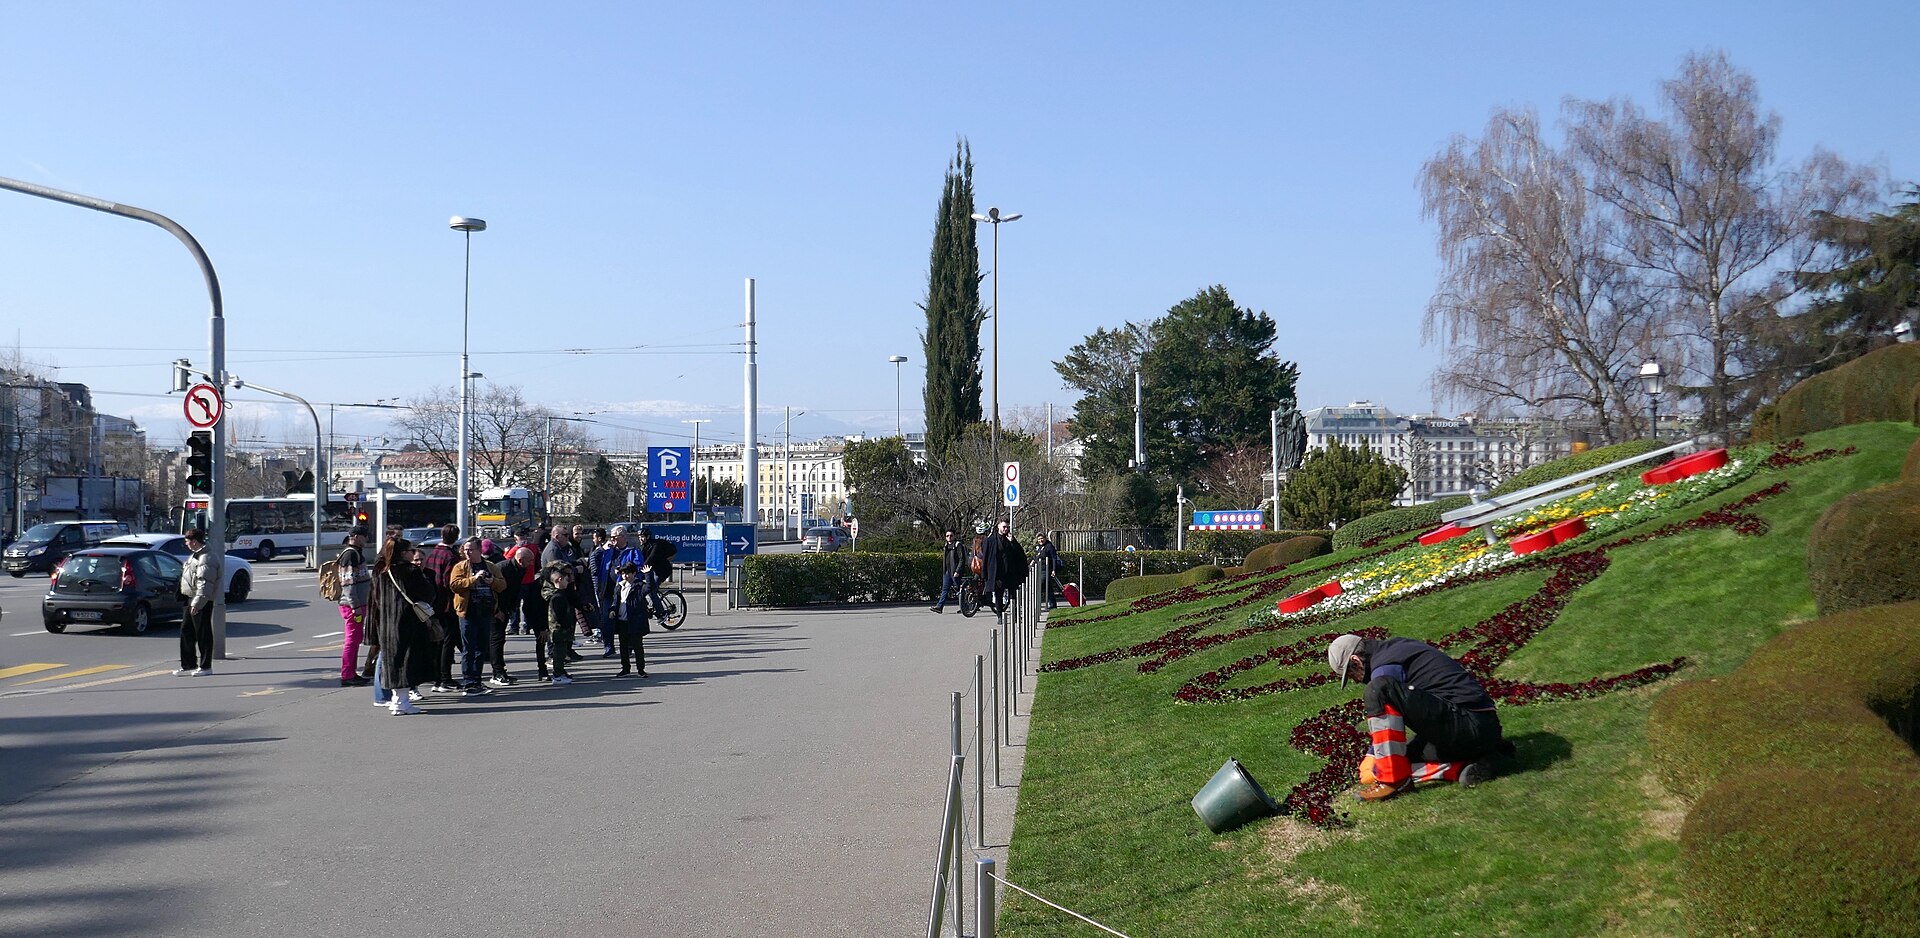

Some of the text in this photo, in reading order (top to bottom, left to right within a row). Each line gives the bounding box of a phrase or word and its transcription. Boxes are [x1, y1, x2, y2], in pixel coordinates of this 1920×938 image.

[660, 455, 678, 477] P
[669, 491, 686, 500] XXX
[655, 534, 680, 543] Parking
